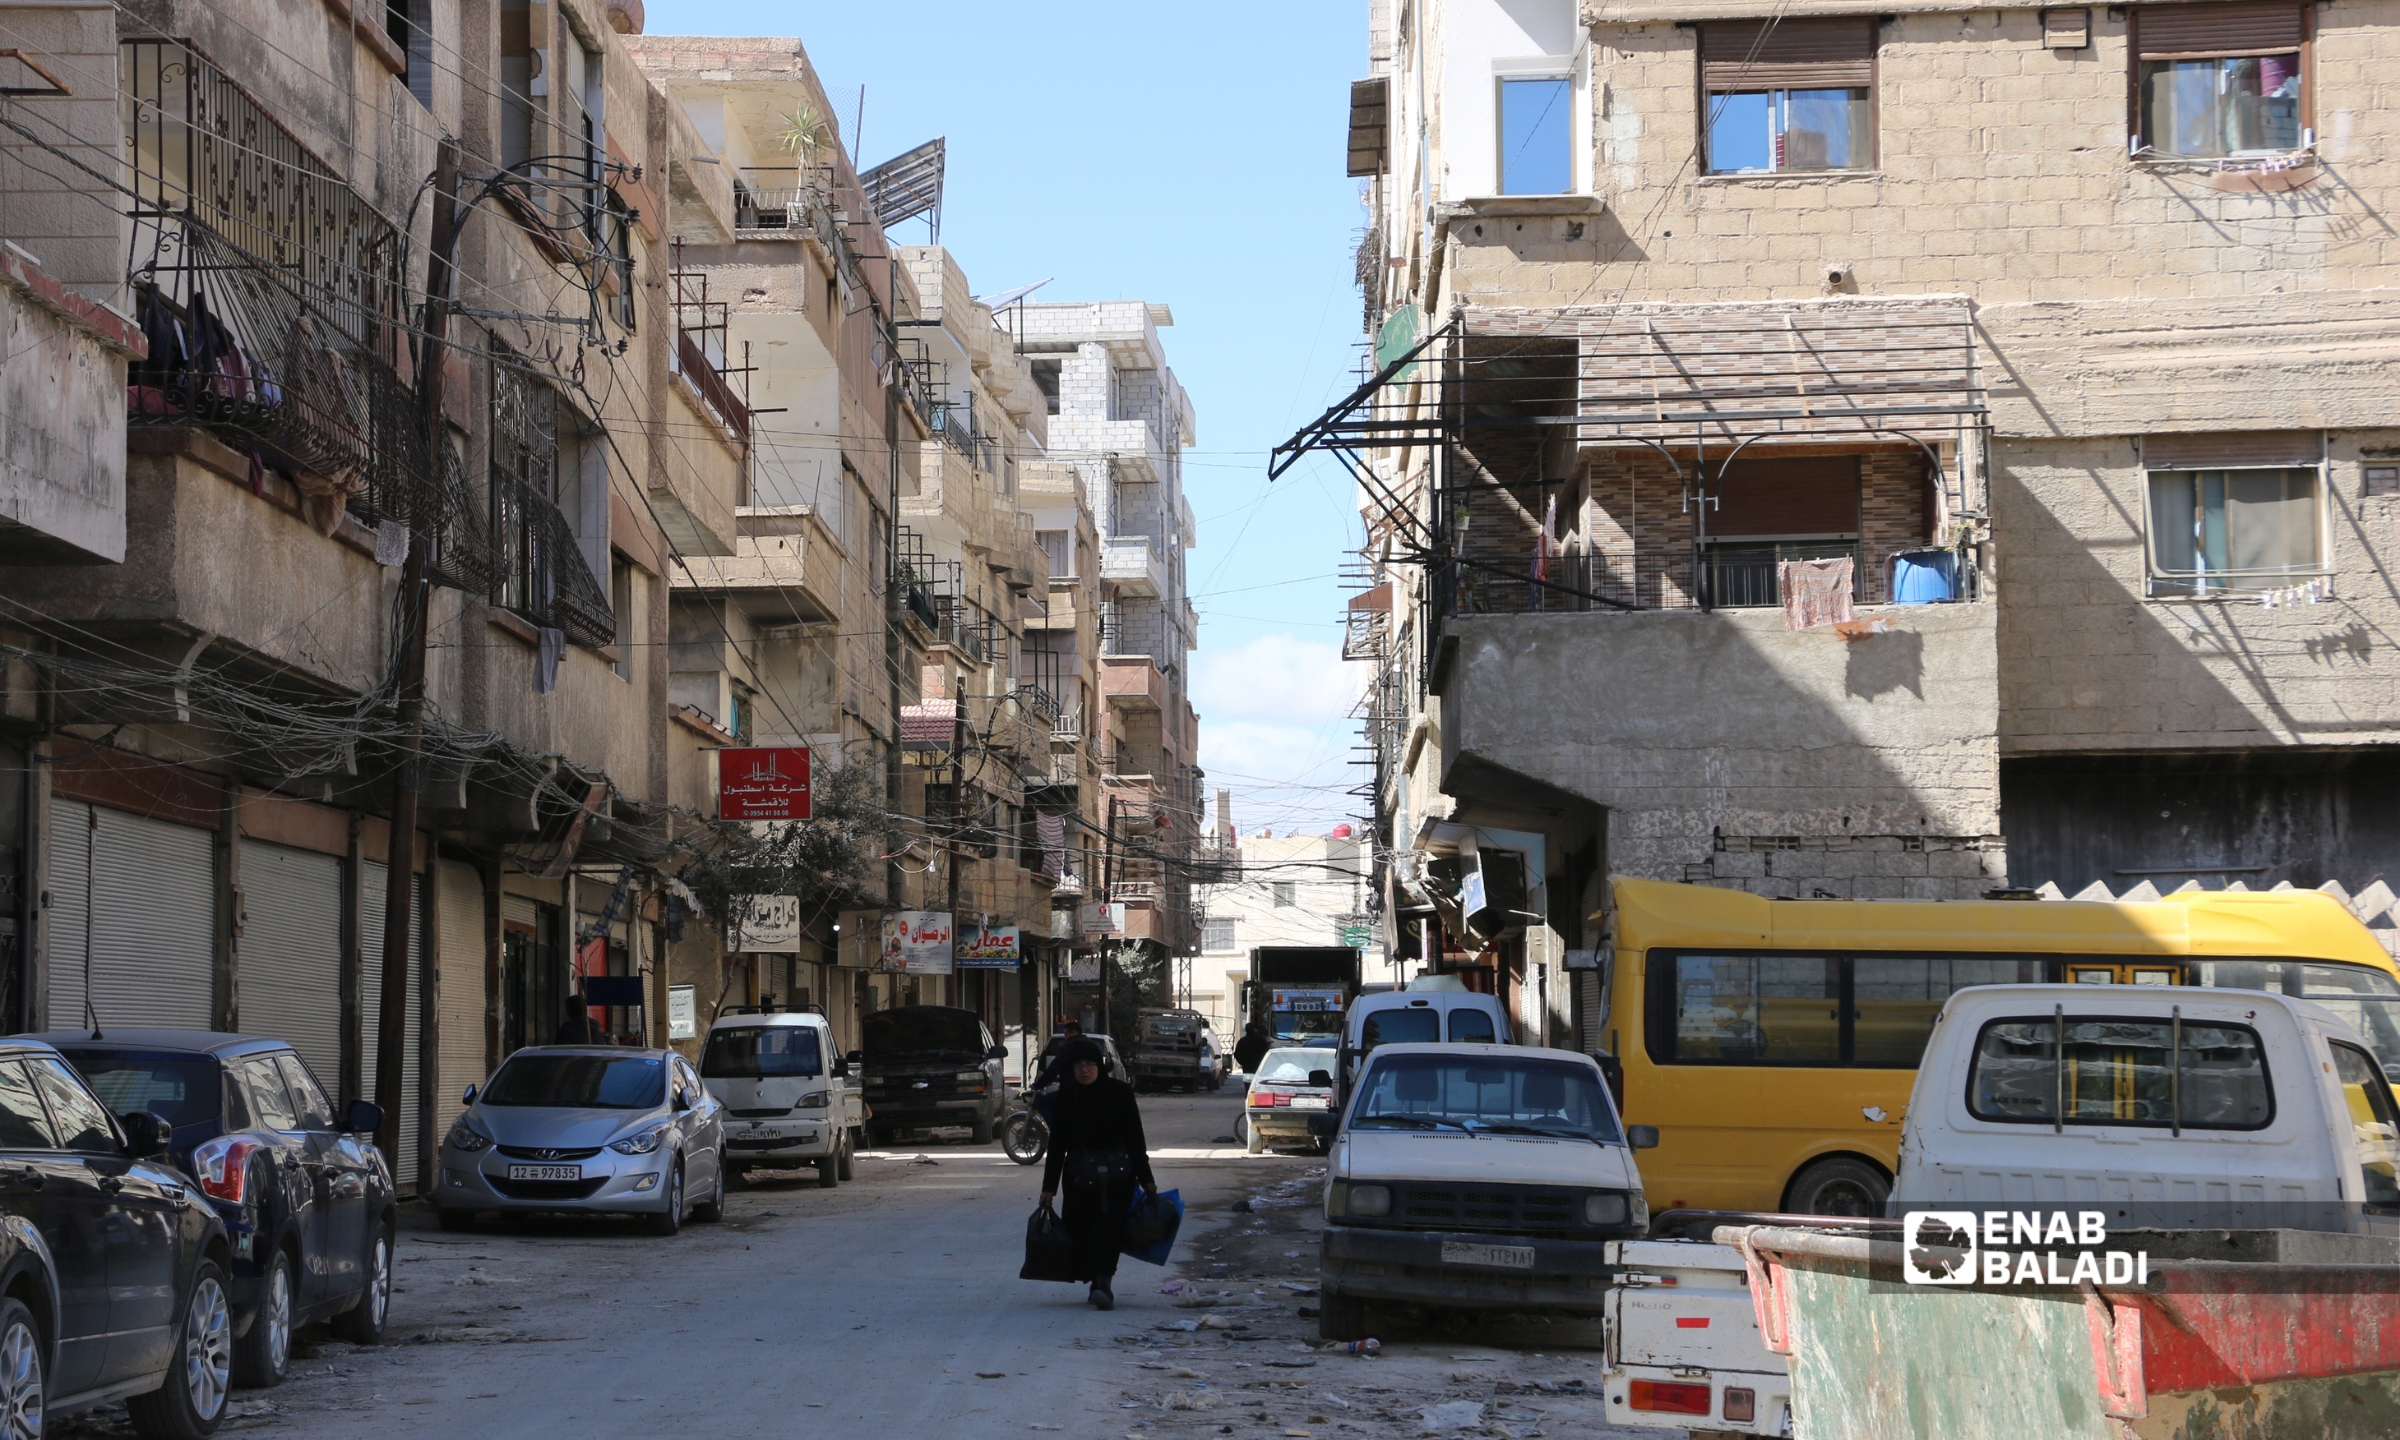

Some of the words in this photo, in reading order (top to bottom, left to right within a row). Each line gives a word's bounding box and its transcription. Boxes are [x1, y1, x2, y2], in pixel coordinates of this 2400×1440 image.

[723, 784, 765, 795] اسطنبول
[768, 783, 807, 794] شركة
[741, 797, 789, 807] للأقمشة
[749, 809, 764, 817] 0954
[764, 809, 772, 817] 41
[774, 900, 797, 928] كراج
[911, 925, 950, 944] الرضوان
[969, 929, 1015, 951] عمار
[513, 1167, 527, 1178] 12
[541, 1167, 575, 1179] 97835
